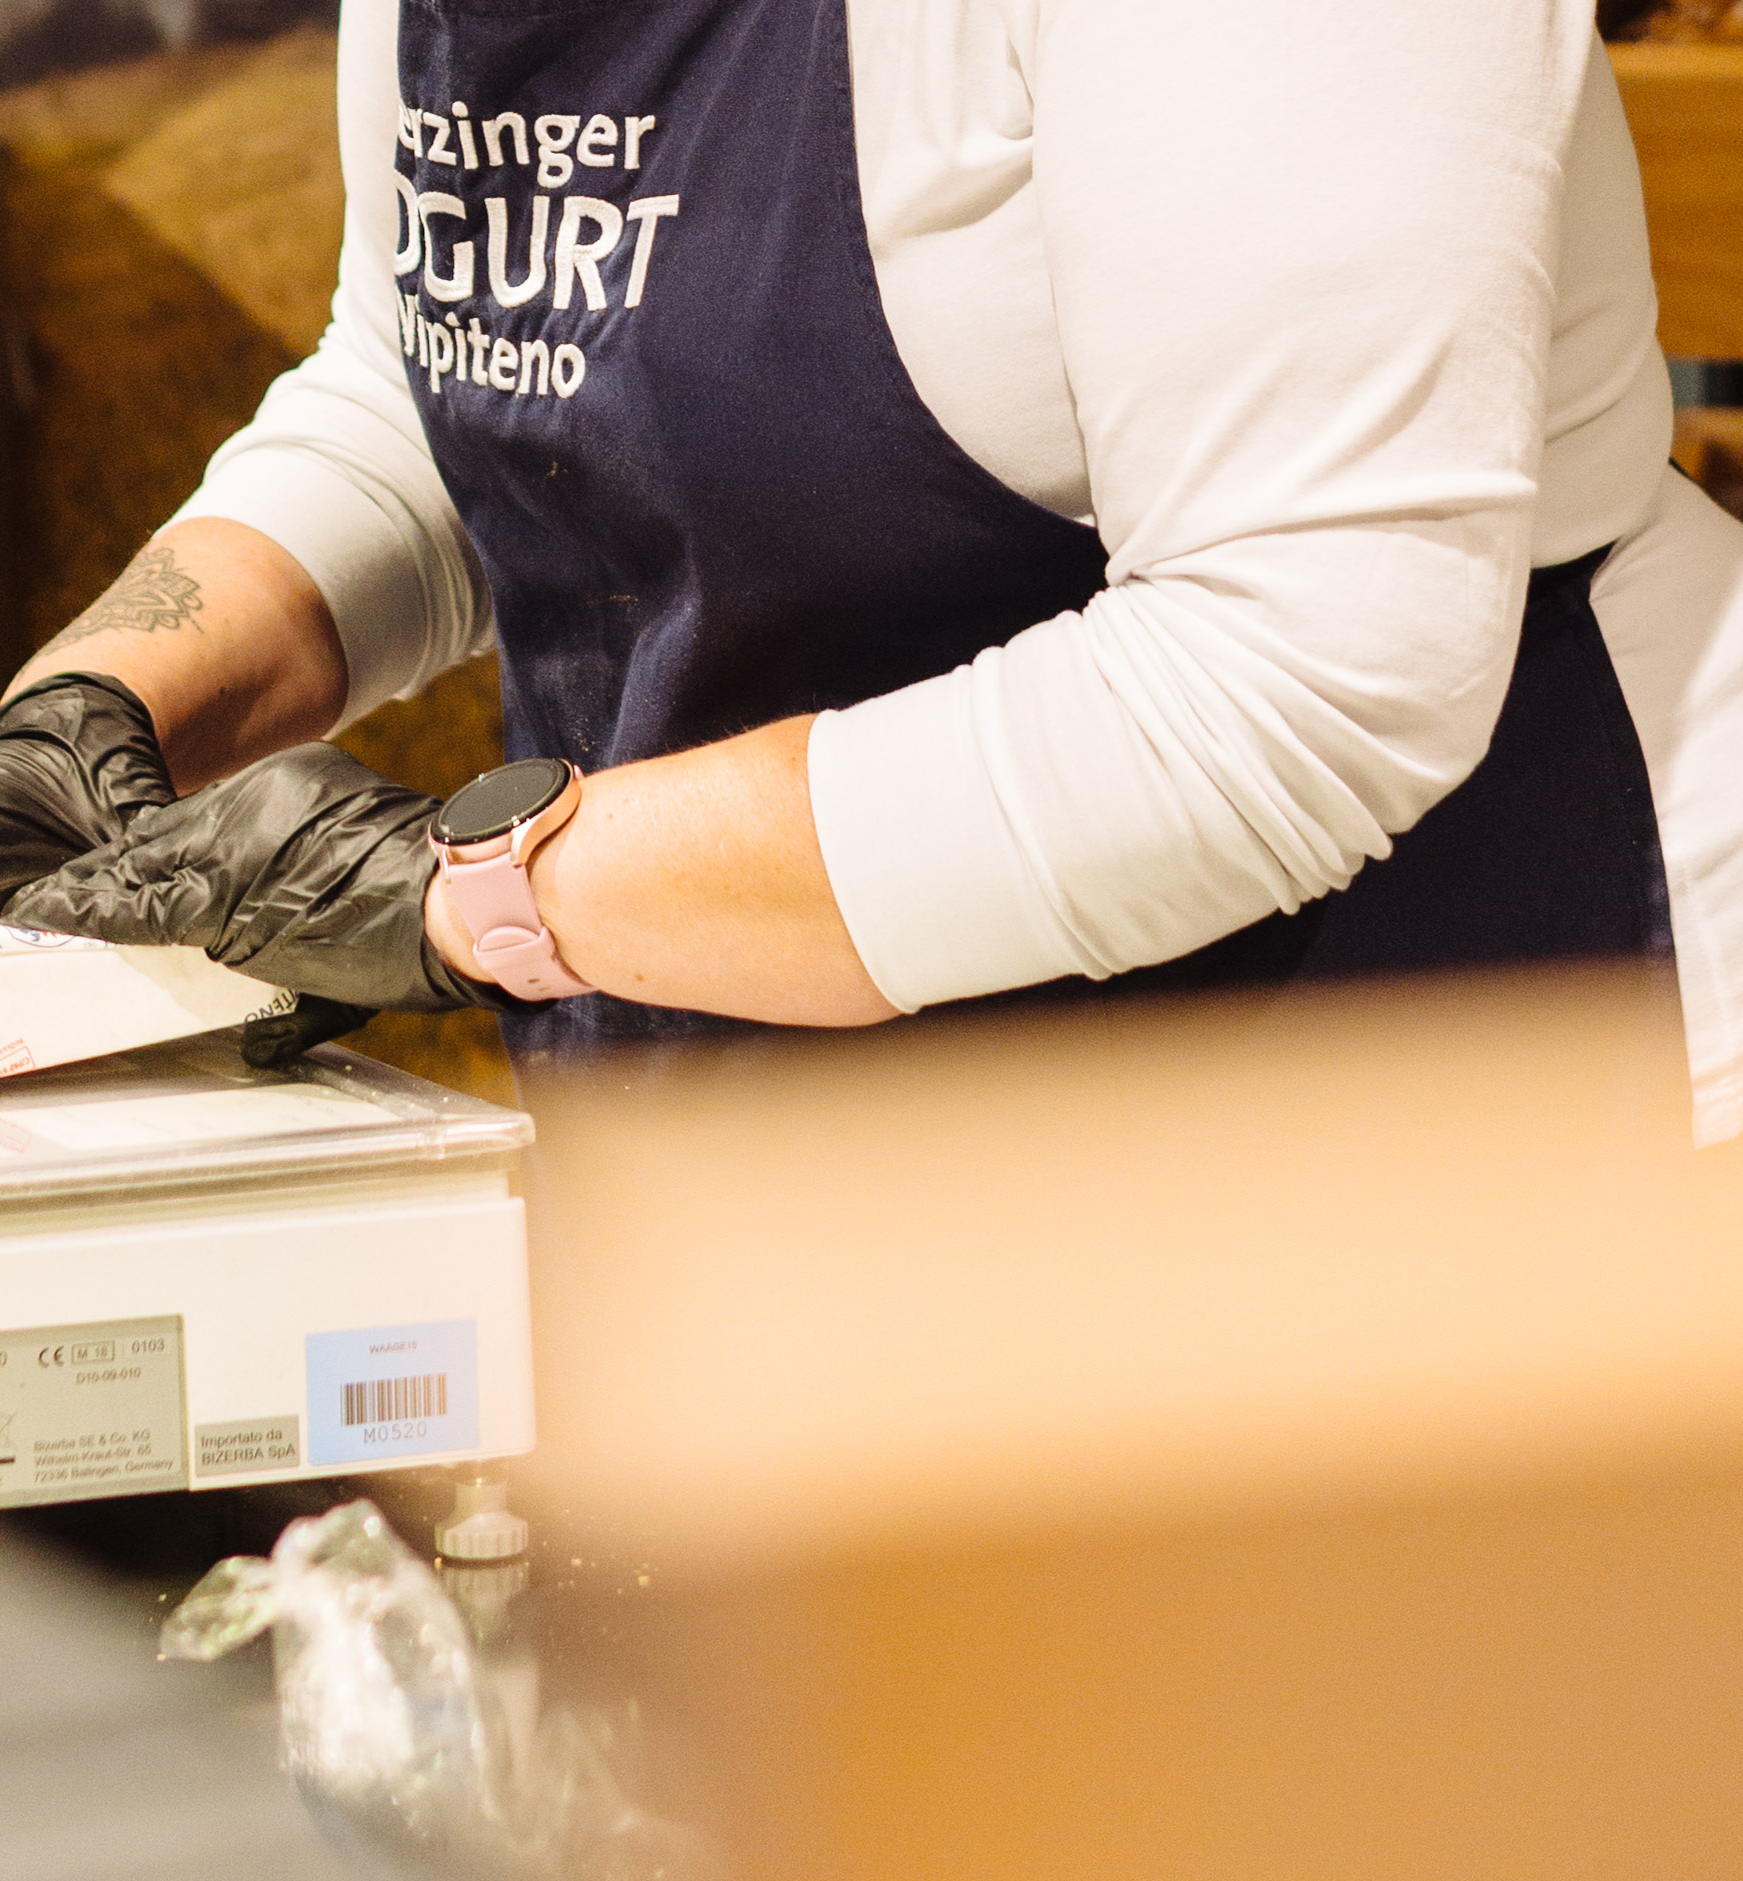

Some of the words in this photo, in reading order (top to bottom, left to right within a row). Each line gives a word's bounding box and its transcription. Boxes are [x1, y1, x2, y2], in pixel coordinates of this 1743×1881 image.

[131, 1338, 165, 1354] 0103
[200, 1432, 263, 1450] Importato
[266, 1428, 283, 1442] da
[362, 1421, 428, 1444] M0520
[201, 1446, 265, 1466] BIZERBA
[268, 1443, 296, 1461] SpA
